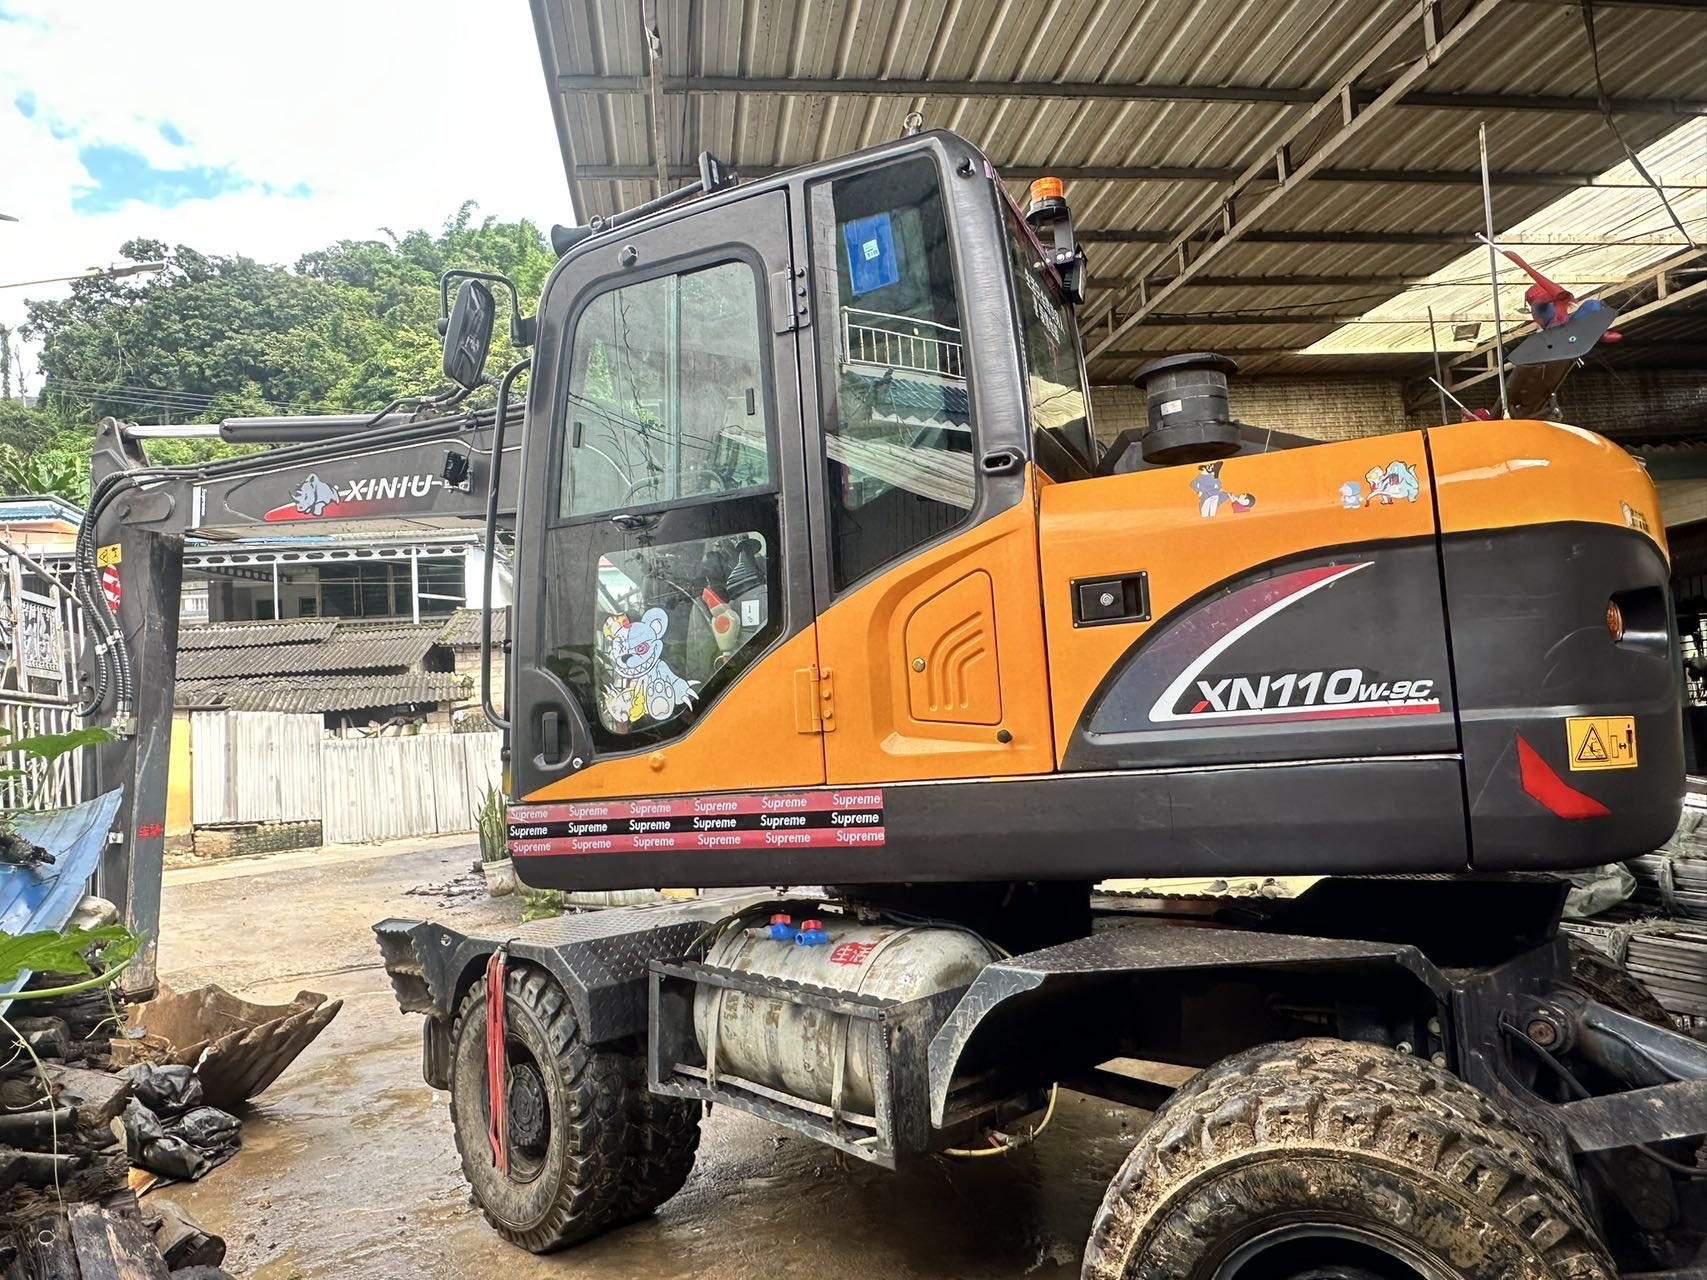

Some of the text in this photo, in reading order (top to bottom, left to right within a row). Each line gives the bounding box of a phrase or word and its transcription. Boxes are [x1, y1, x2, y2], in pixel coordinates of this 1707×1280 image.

[345, 474, 434, 502] XINIU
[511, 794, 881, 821] Supreme Supreme Supreme Supreme Supreme Supreme
[509, 812, 879, 838] Supreme Supreme Supreme Supreme Supreme Supreme
[513, 831, 885, 854] Supreme Supreme Supreme Supreme Supreme Supreme
